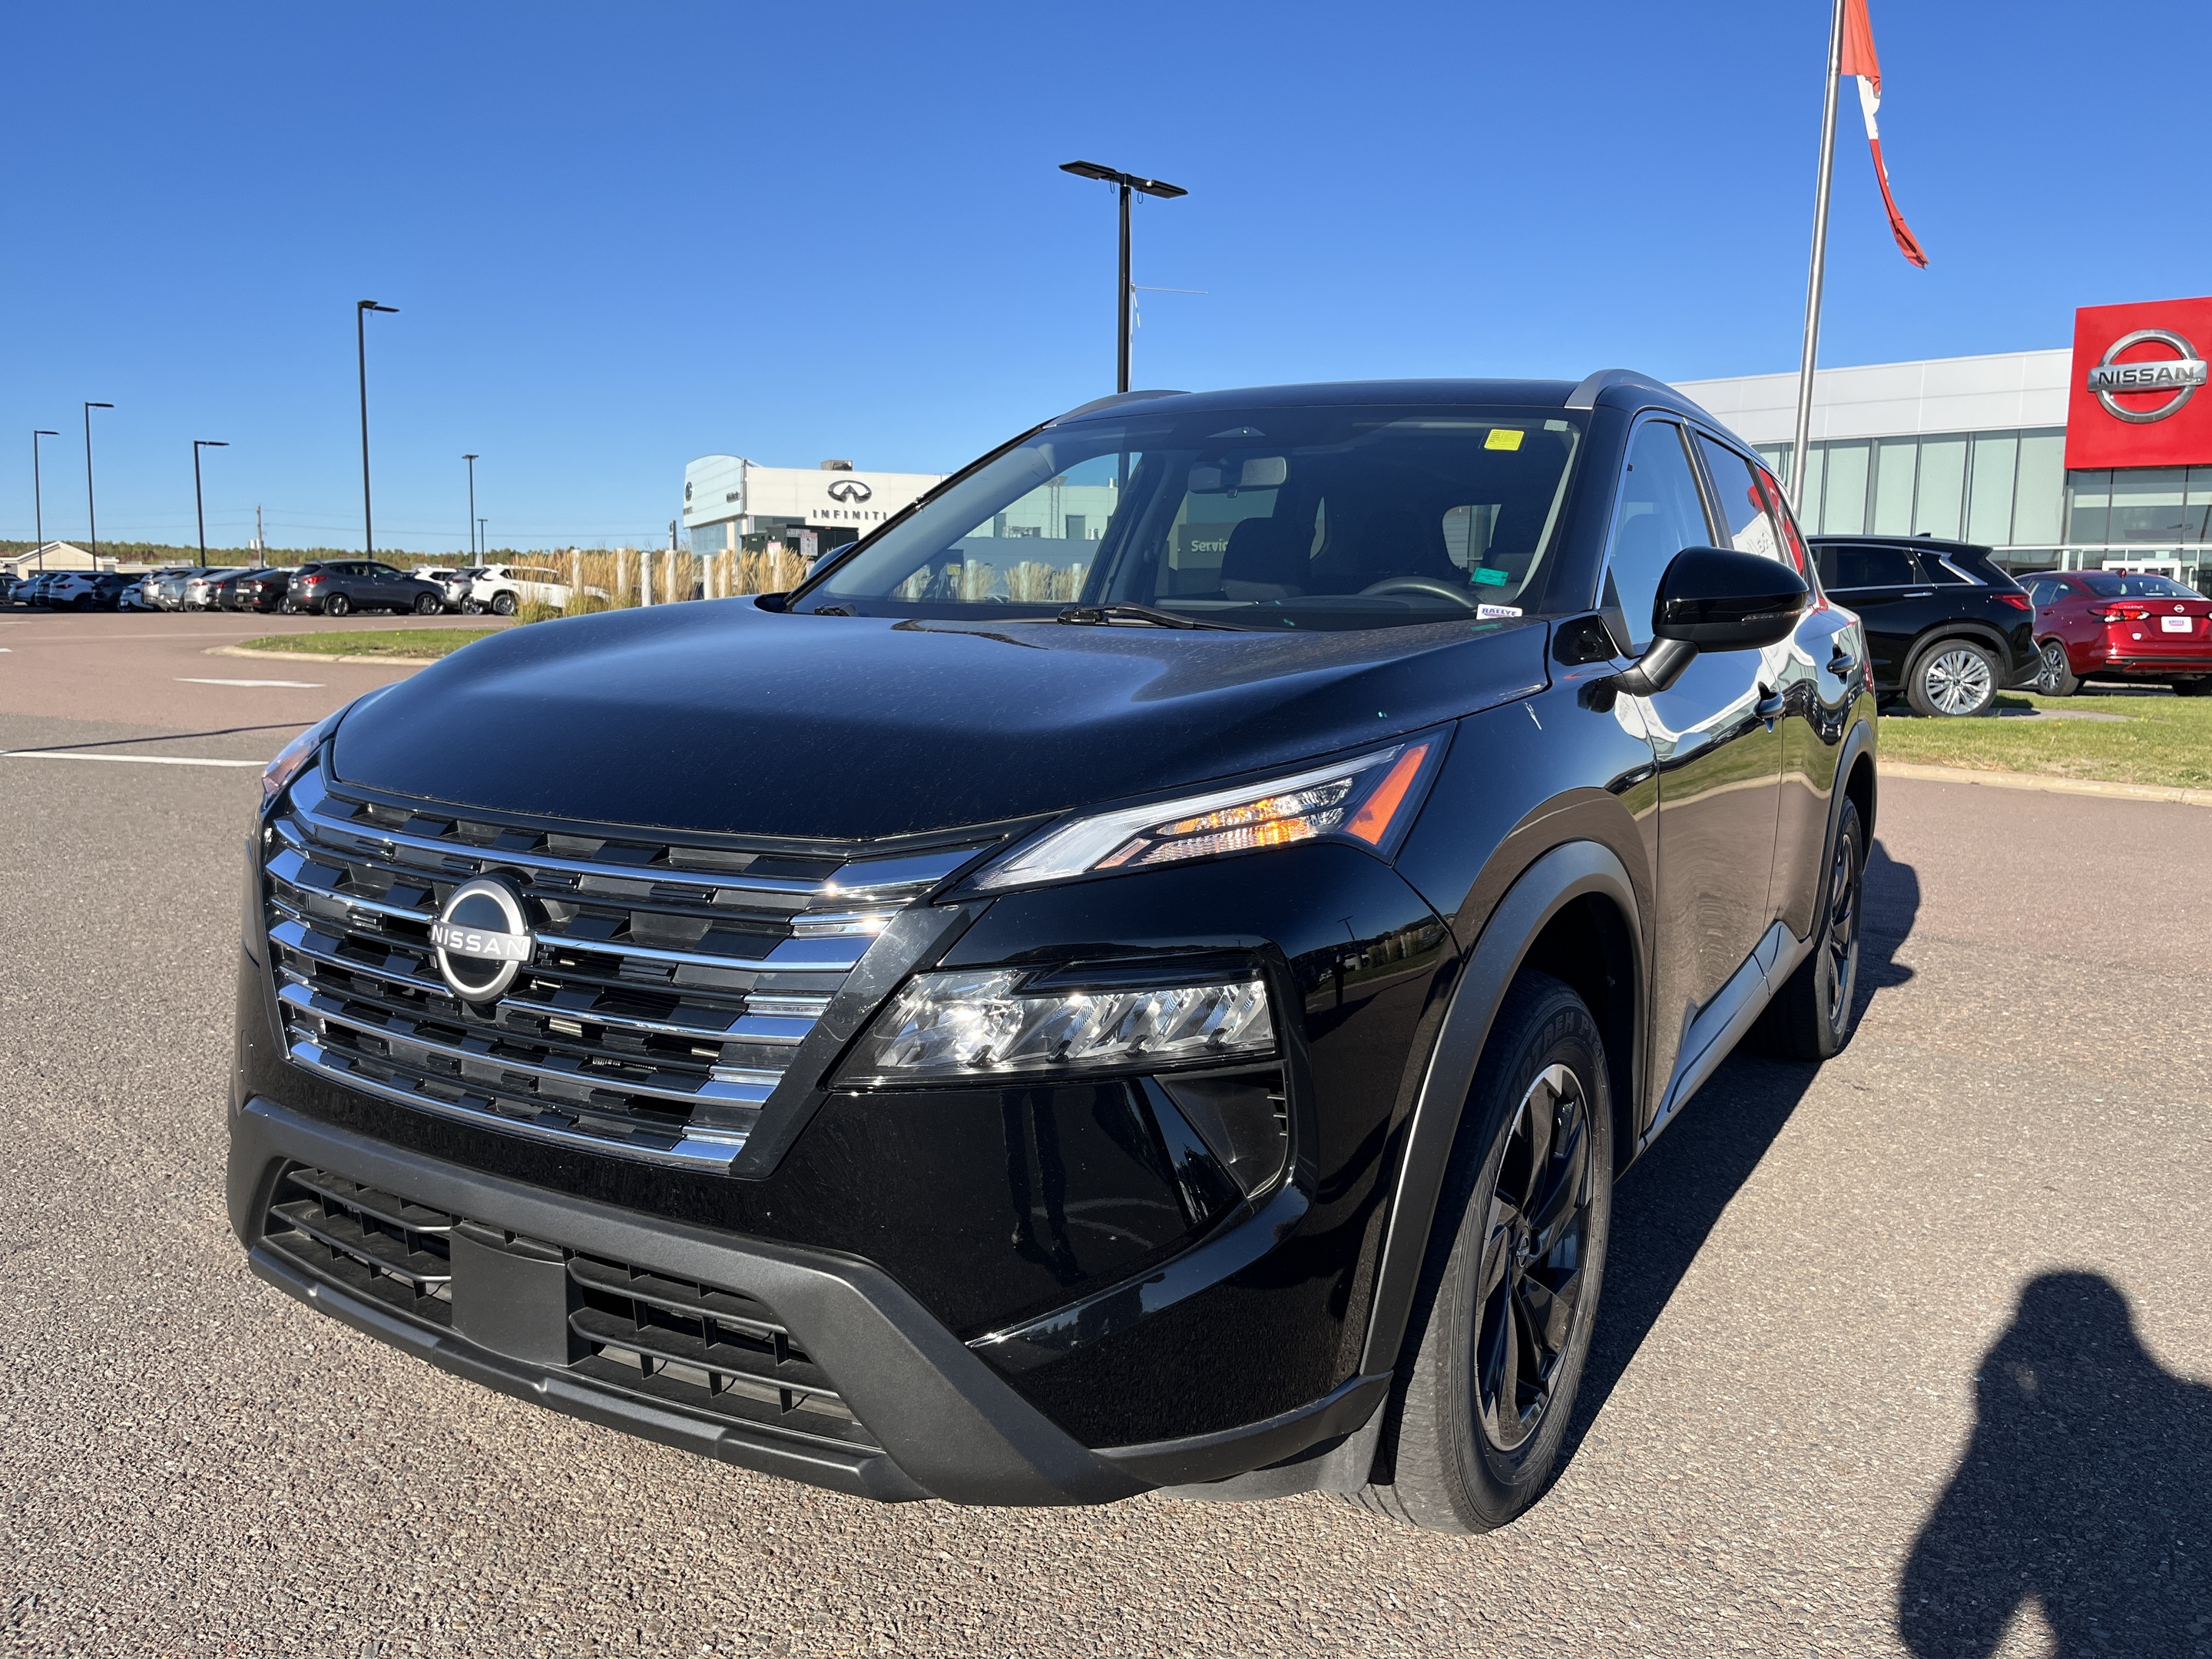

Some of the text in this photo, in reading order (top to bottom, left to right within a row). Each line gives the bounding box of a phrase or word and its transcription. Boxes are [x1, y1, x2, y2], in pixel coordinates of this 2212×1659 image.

[2098, 368, 2194, 385] NISSAN
[813, 509, 887, 521] INFINITI
[432, 924, 527, 957] NISSAN
